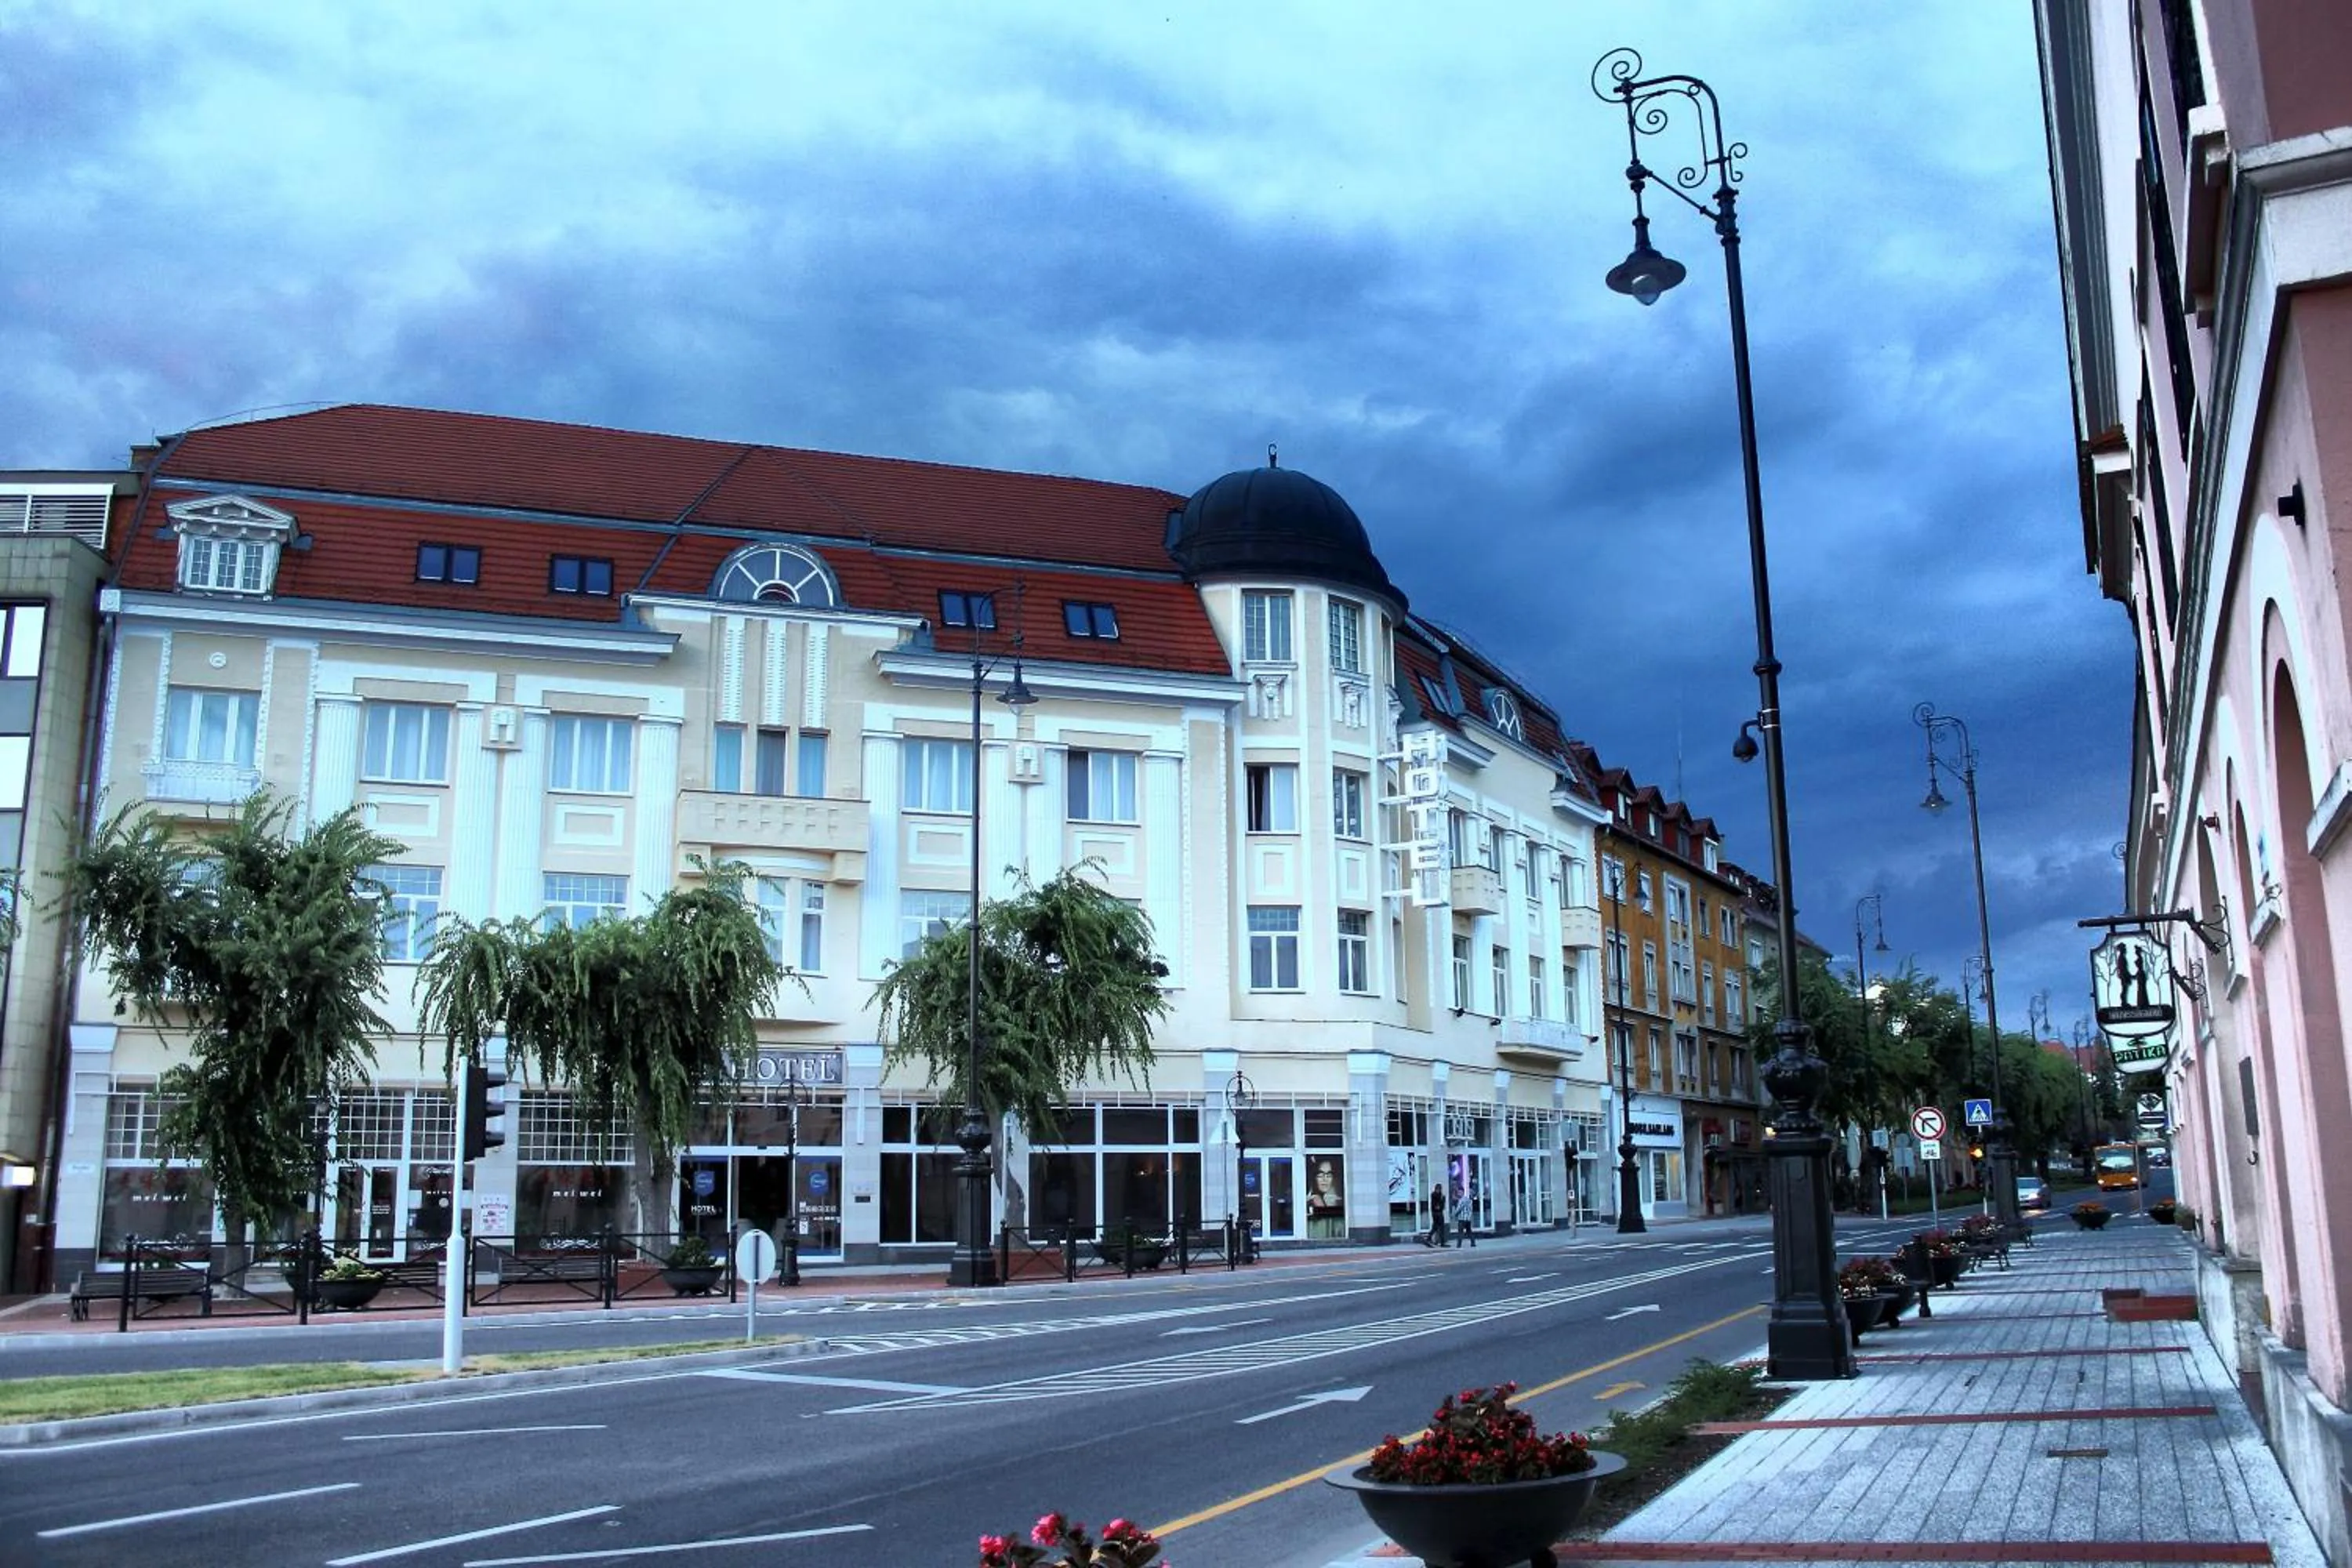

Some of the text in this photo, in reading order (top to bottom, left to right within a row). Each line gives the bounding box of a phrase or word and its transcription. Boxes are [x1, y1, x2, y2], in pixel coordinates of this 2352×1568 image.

[1403, 728, 1443, 906] HOTEL
[2114, 1045, 2166, 1062] PATIKA
[731, 1058, 835, 1080] HOTEL
